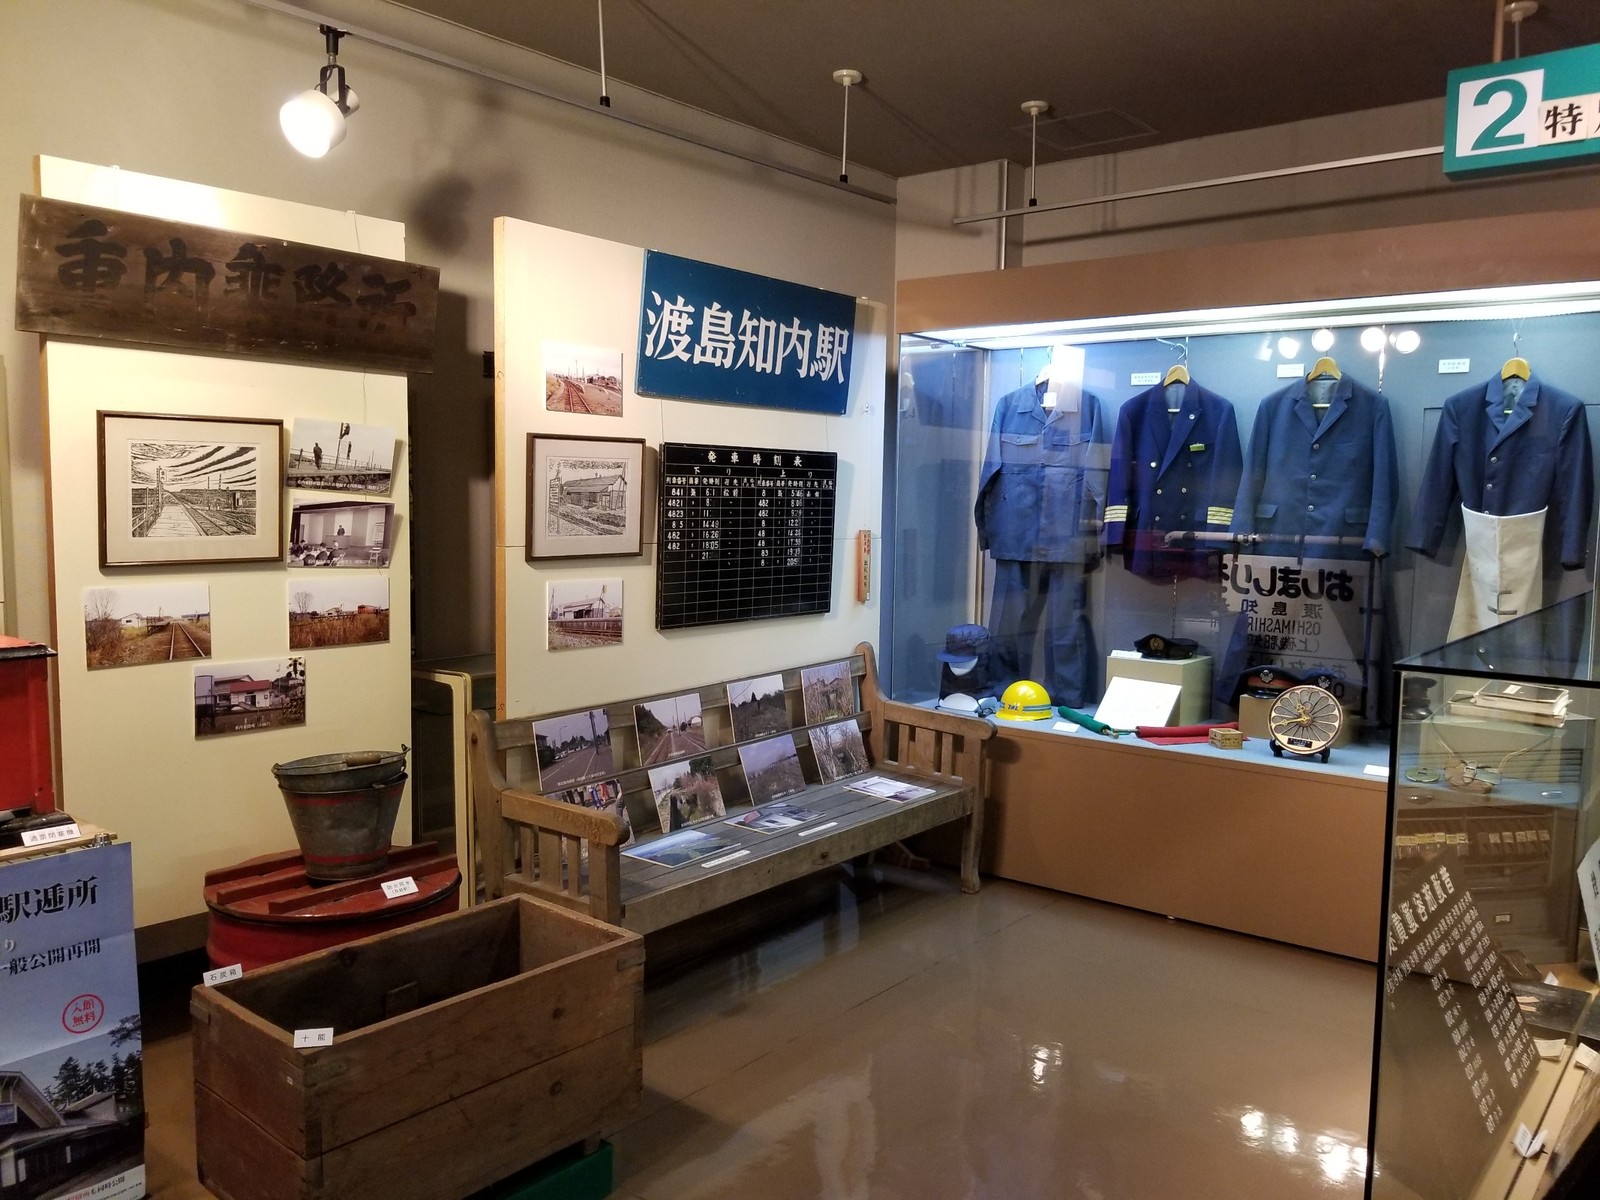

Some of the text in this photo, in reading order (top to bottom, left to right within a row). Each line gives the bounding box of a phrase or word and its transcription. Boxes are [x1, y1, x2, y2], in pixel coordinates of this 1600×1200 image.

[1471, 78, 1600, 151] 2 特
[645, 290, 850, 384] 渡島知内駅
[708, 450, 802, 468] 発車時刻表
[72, 1010, 96, 1028] 無料
